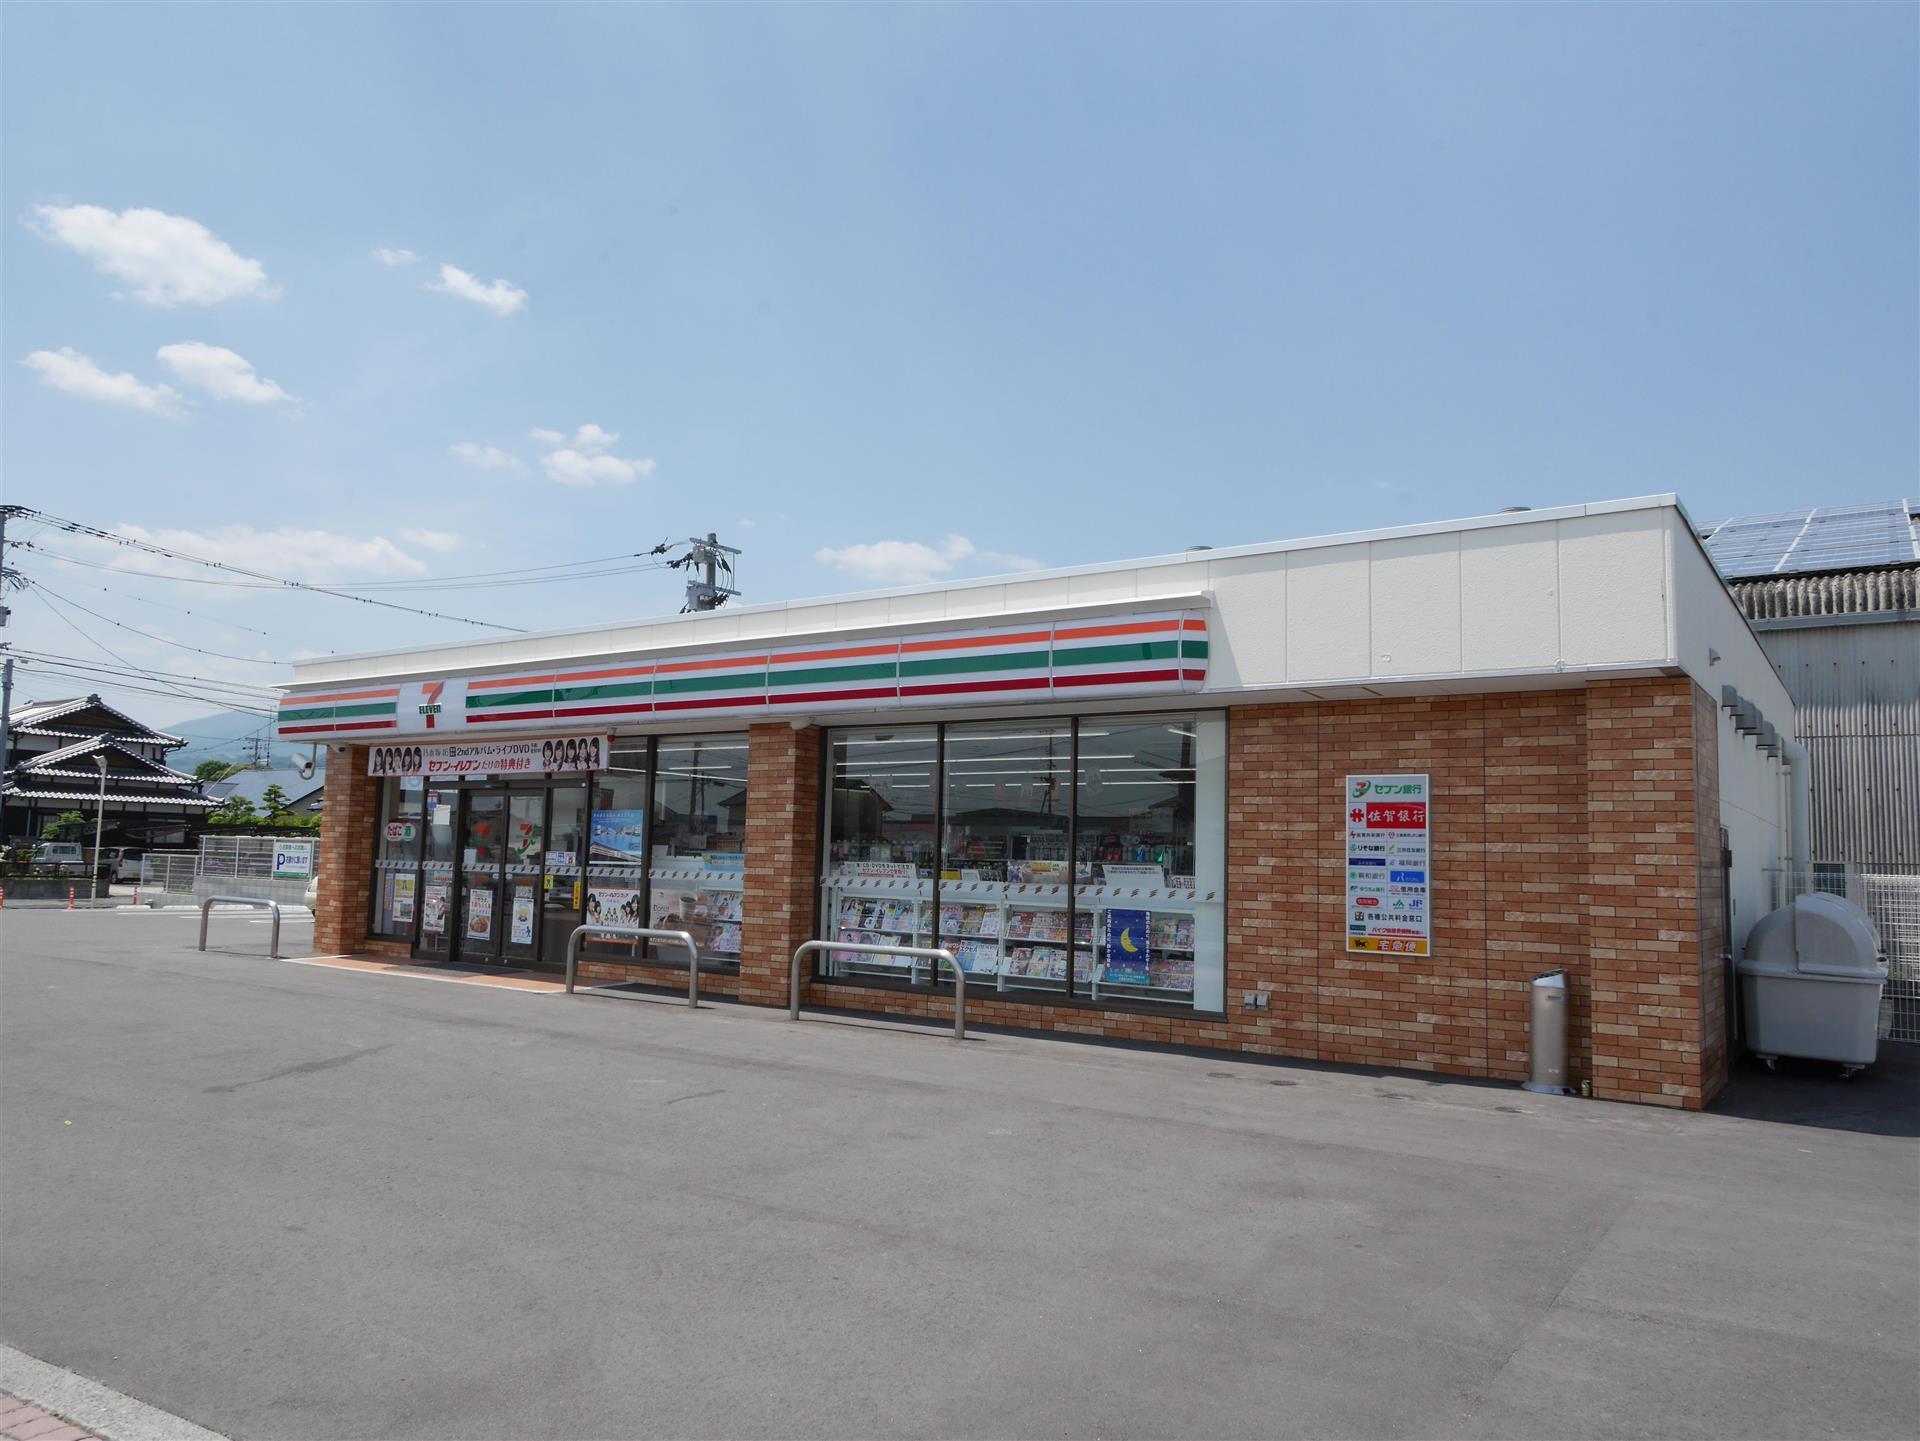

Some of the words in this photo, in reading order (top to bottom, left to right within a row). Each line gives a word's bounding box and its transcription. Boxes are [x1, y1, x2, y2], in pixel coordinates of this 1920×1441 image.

[1374, 783, 1422, 795] セブン銀行
[1368, 809, 1425, 823] 佐賀銀行
[1357, 844, 1386, 852] りそな銀行
[1367, 913, 1422, 922] 各種公共料金窓口
[1378, 941, 1417, 952] 宅急便
